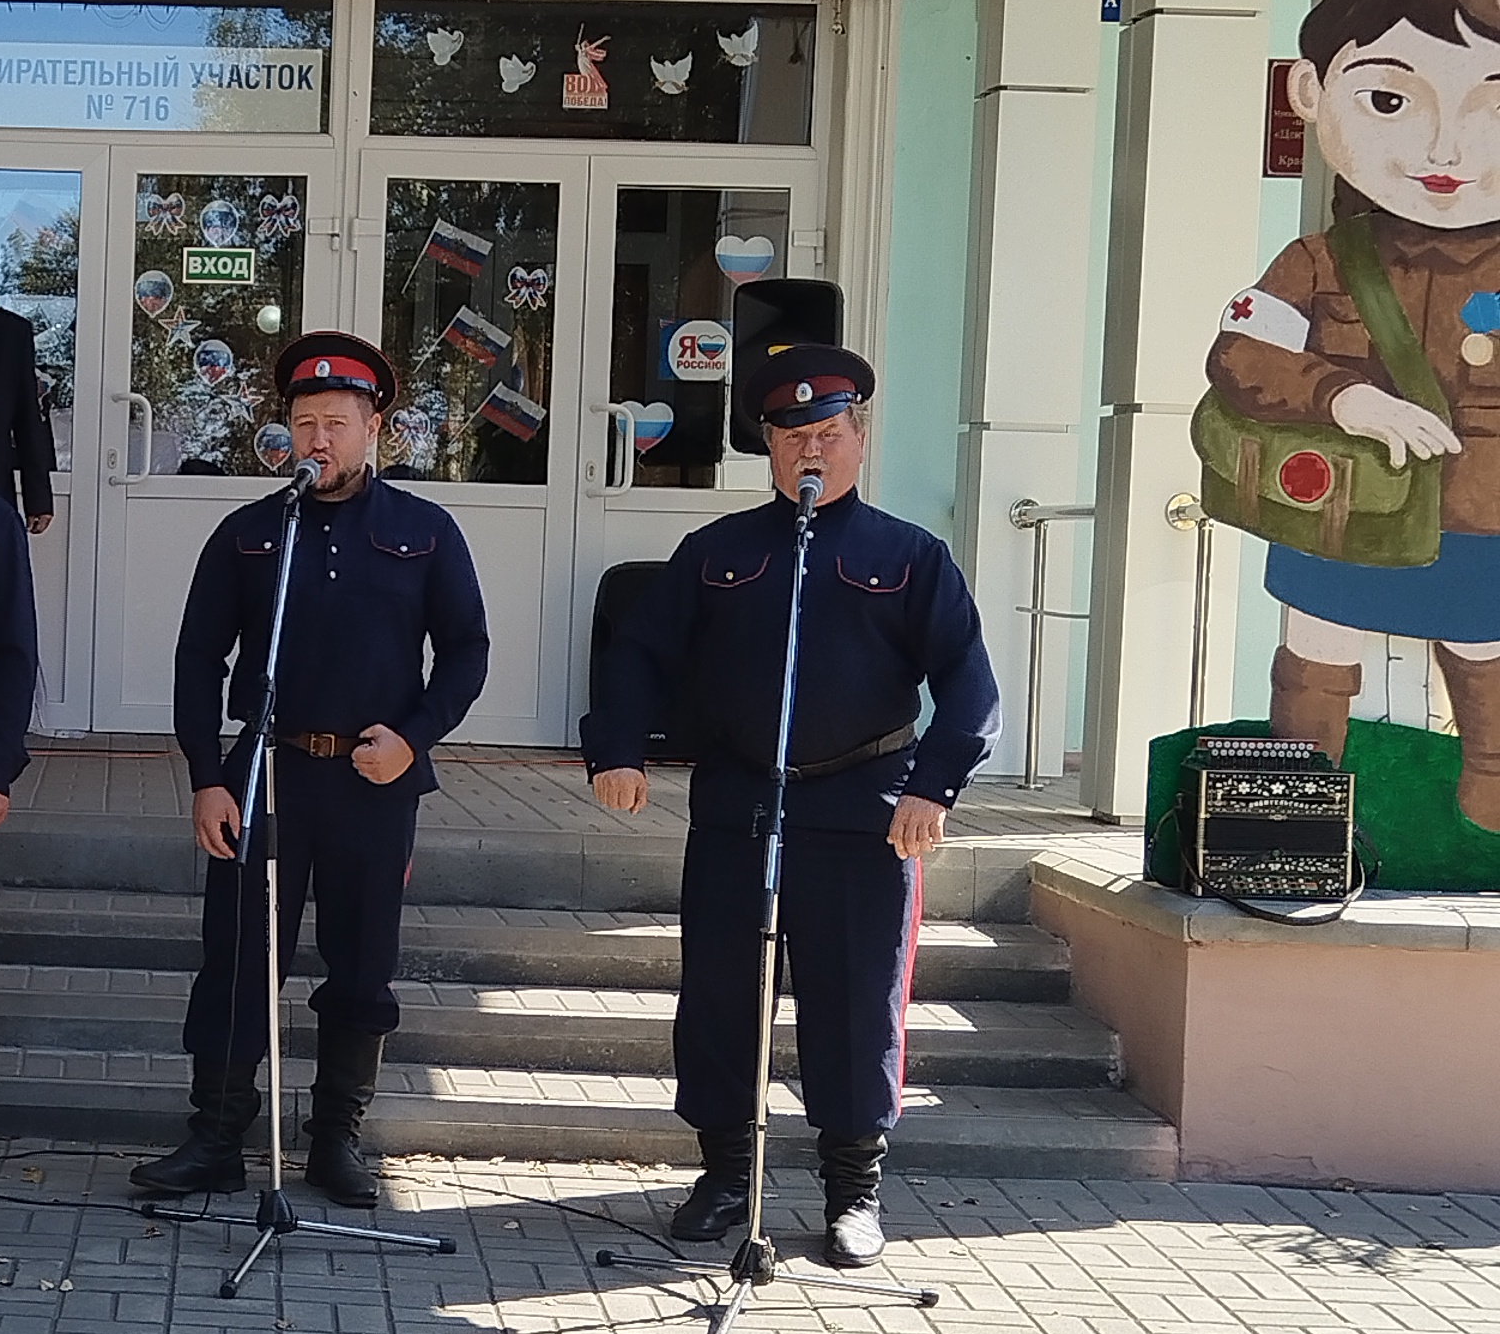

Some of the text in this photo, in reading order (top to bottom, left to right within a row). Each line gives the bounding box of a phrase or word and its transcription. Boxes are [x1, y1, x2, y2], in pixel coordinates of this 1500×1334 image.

[188, 61, 314, 91] УЧАСТОК
[86, 94, 170, 122] № 716
[188, 256, 249, 279] ВХОД
[678, 335, 697, 359] Я
